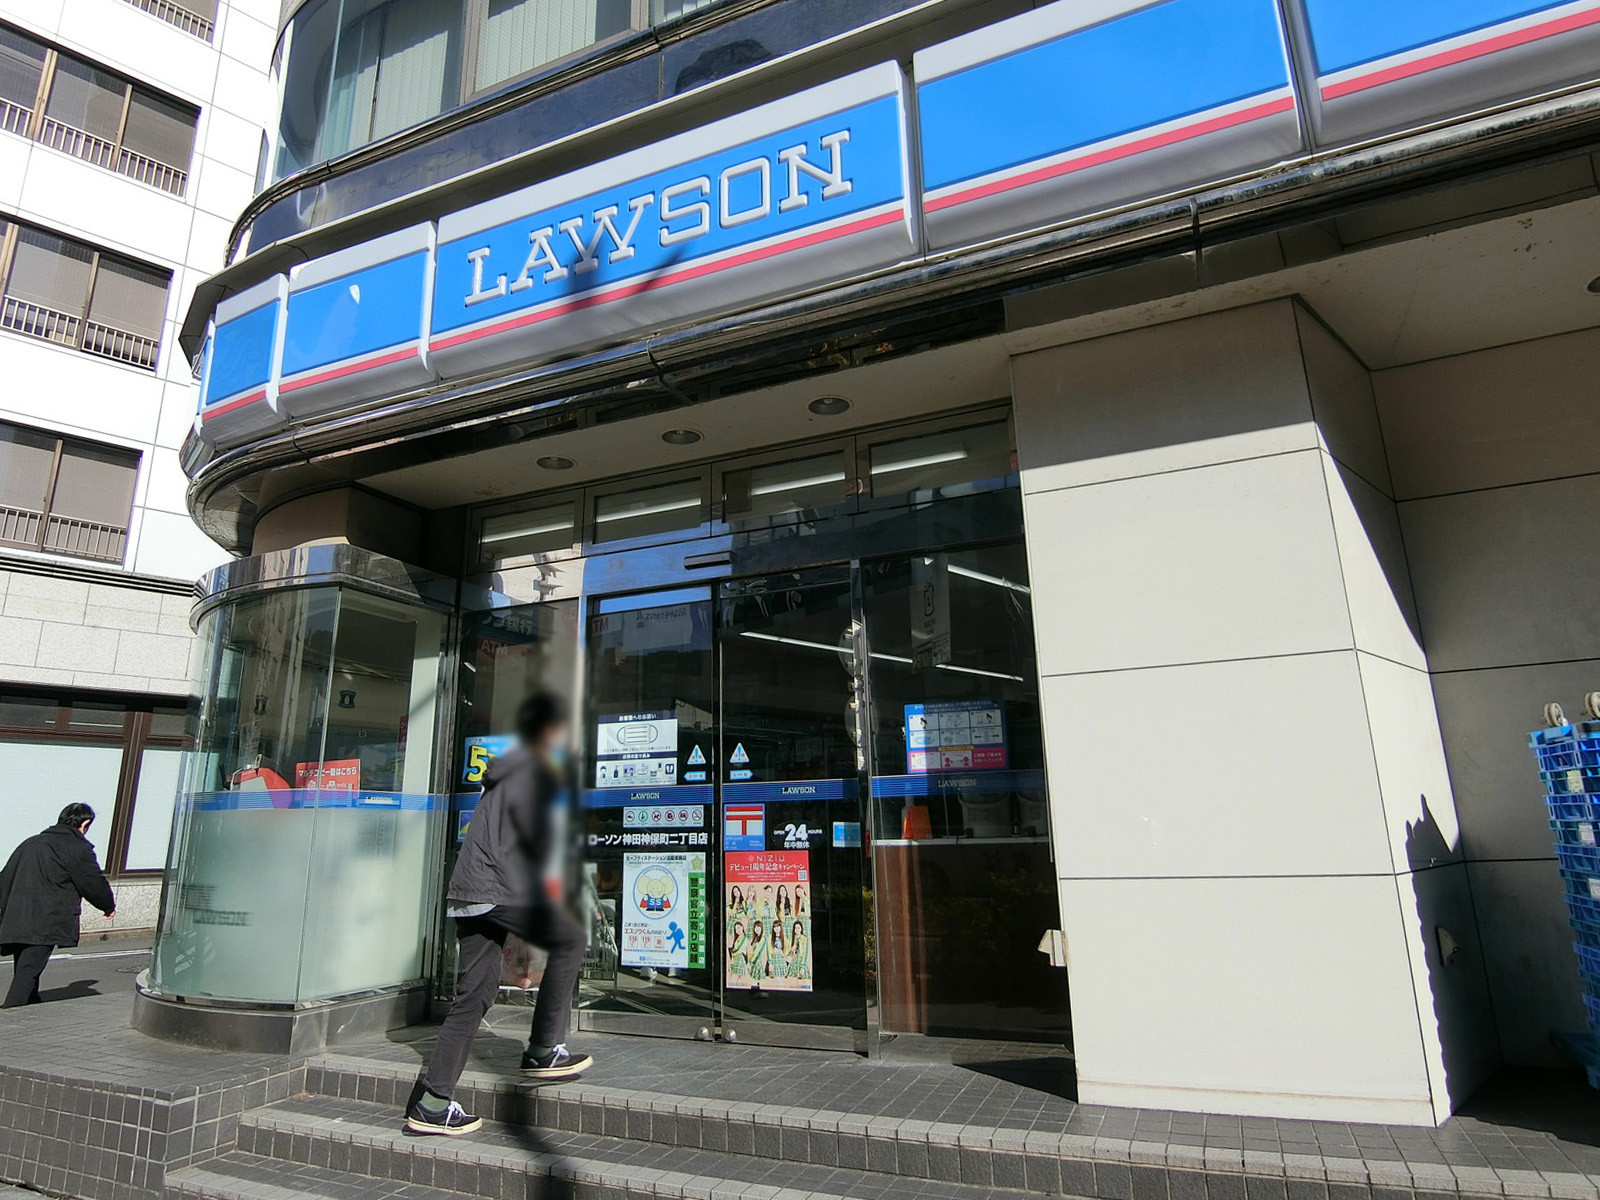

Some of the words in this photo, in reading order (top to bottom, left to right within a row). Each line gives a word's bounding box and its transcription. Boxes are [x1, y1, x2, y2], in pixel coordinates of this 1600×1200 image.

[465, 129, 853, 307] LAWSON
[481, 639, 509, 657] ATM
[937, 778, 977, 788] LAWSON
[630, 791, 660, 800] LAWSON
[781, 786, 816, 794] LAWSON
[784, 823, 809, 842] 24
[588, 832, 708, 846] ローソン神田神保町二丁目店
[783, 841, 810, 850] 年中無休
